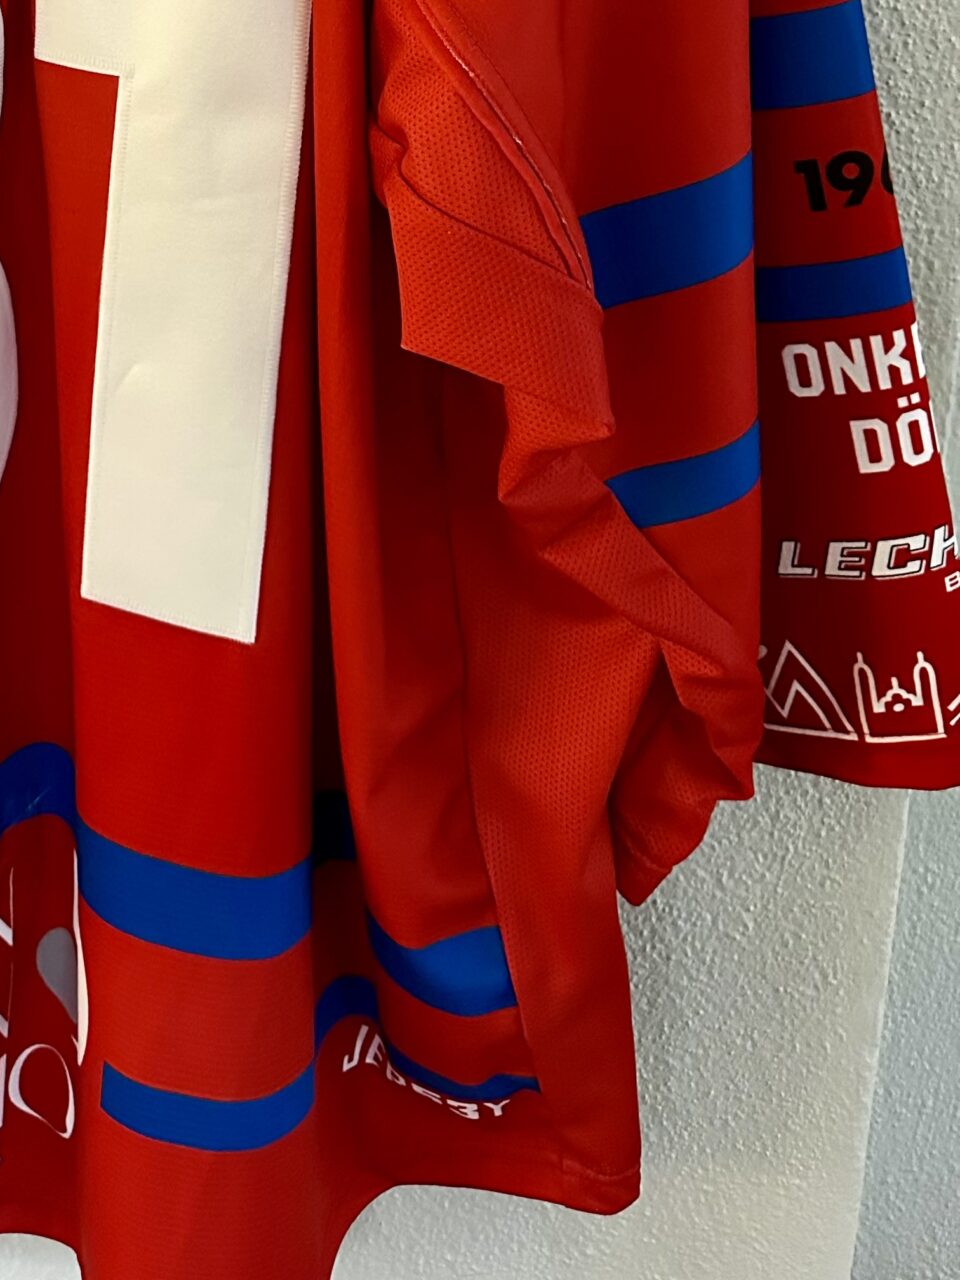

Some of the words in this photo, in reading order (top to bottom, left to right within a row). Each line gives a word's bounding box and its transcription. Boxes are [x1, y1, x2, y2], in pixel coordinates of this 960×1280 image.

[793, 149, 894, 212] 19
[781, 321, 926, 398] ONK
[849, 391, 940, 474] DÖ
